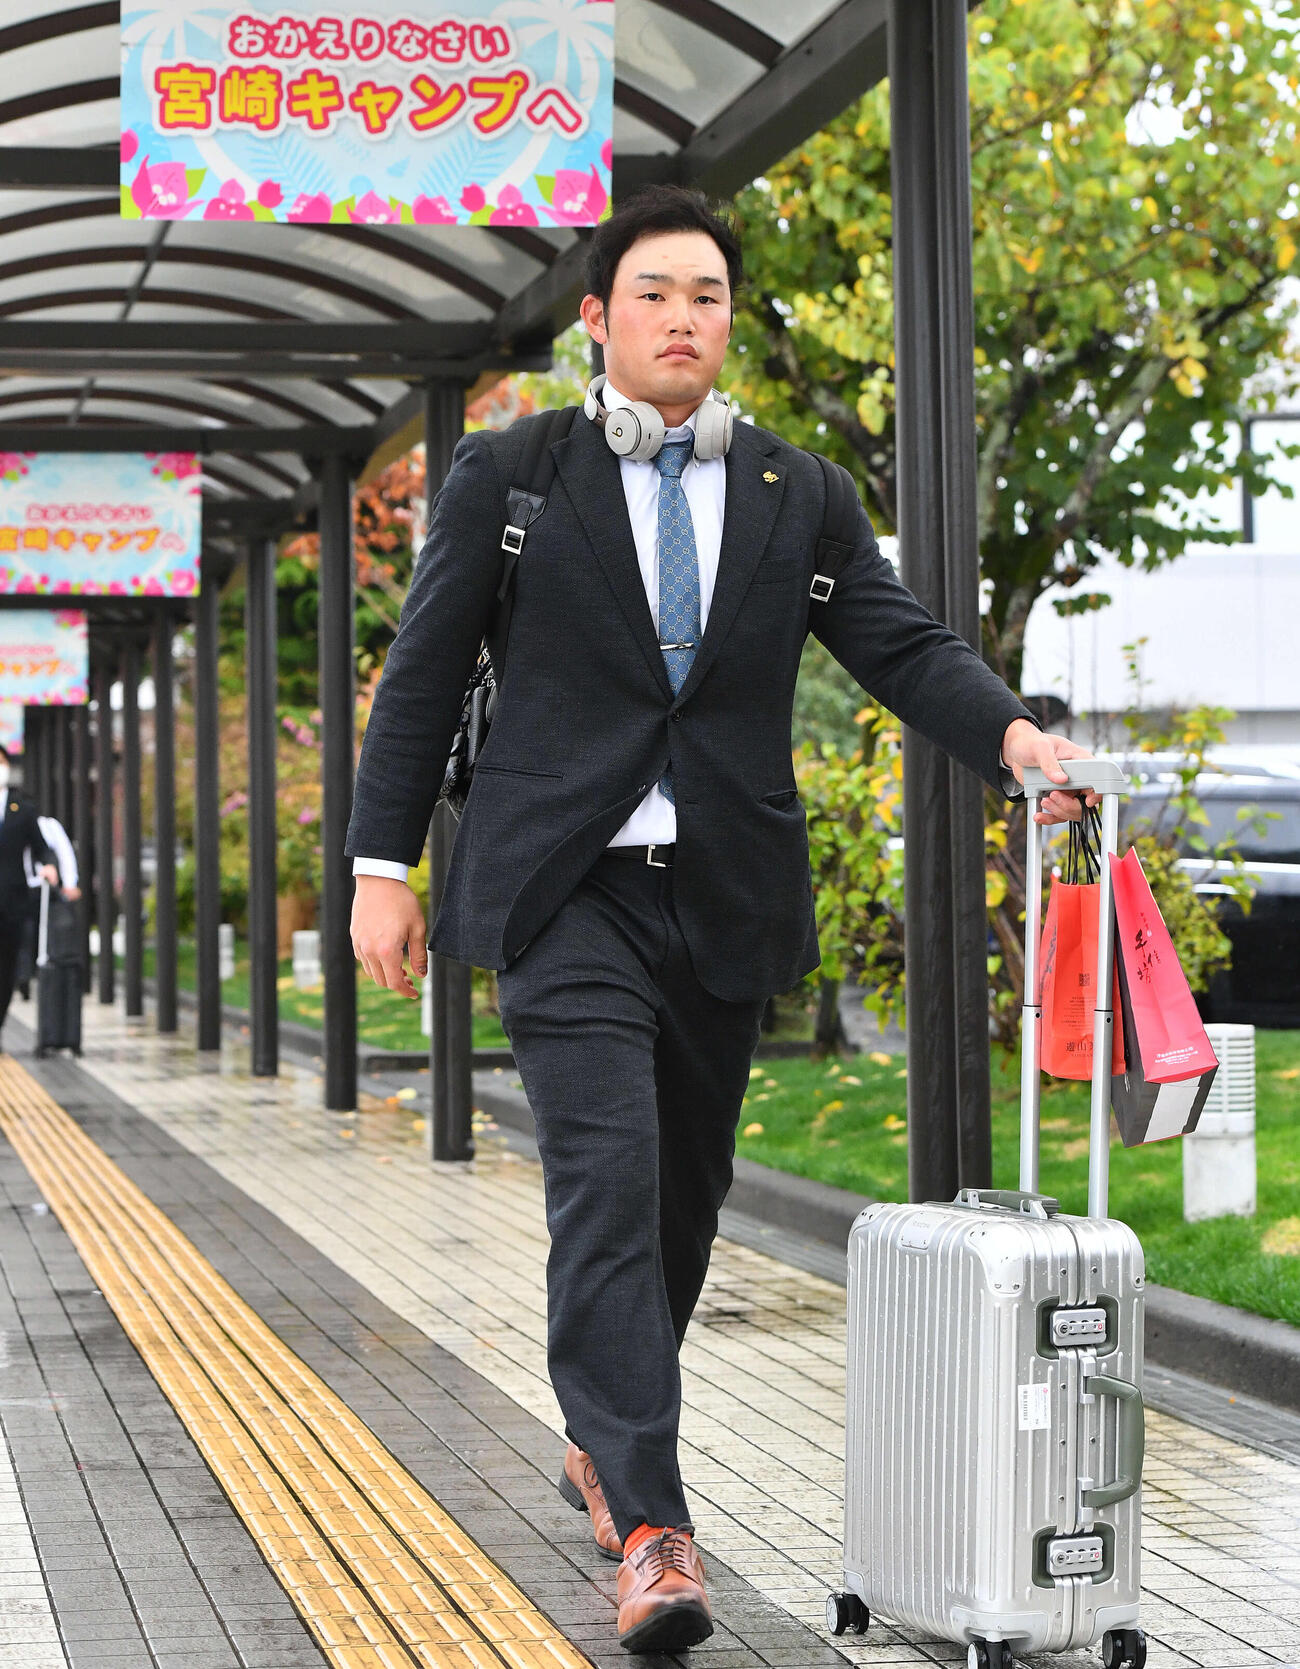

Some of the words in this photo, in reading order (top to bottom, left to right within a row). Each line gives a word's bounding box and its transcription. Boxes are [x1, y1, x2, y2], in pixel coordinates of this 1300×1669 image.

[228, 15, 511, 61] おかえりなさい
[155, 63, 583, 140] 宮崎キャンプへ
